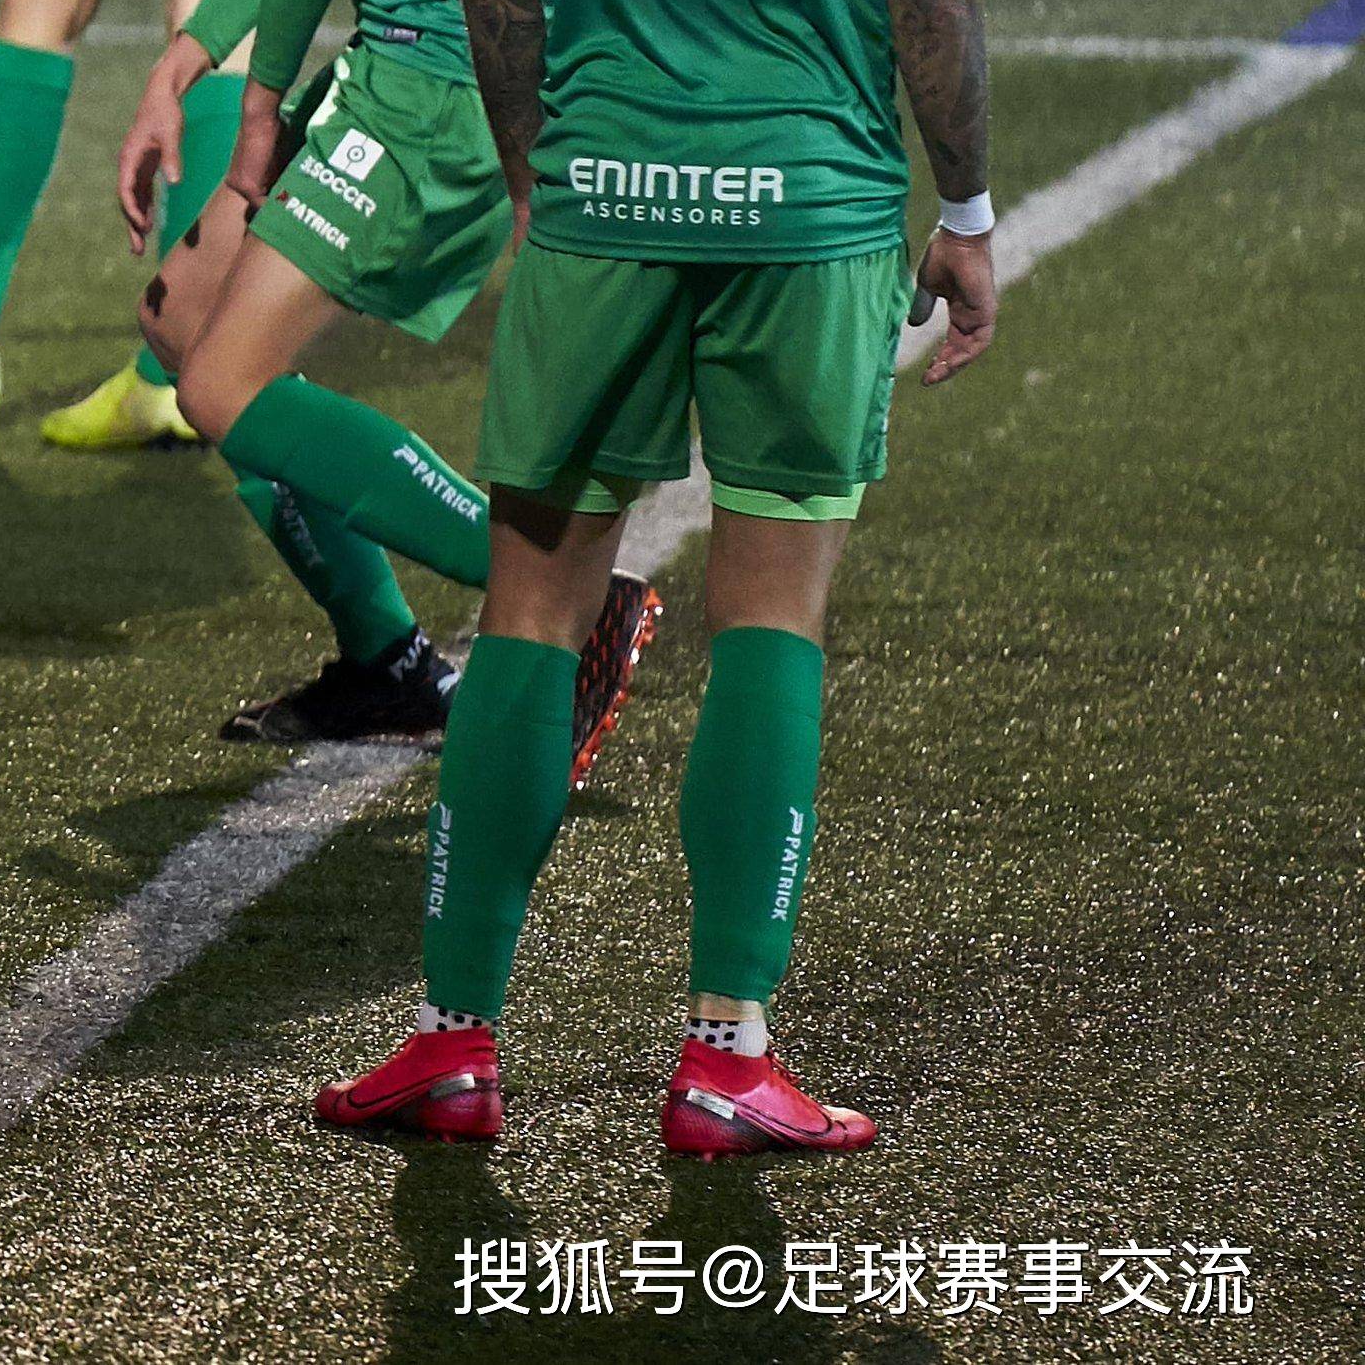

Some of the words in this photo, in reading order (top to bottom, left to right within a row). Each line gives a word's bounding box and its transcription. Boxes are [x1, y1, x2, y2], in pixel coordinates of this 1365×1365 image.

[569, 157, 784, 203] ENINTER
[285, 196, 350, 252] PATRICK
[583, 200, 762, 226] ASCENSORES
[412, 460, 483, 523] PATRICK
[428, 829, 450, 920] PATRICK
[771, 835, 802, 922] PATRICK
